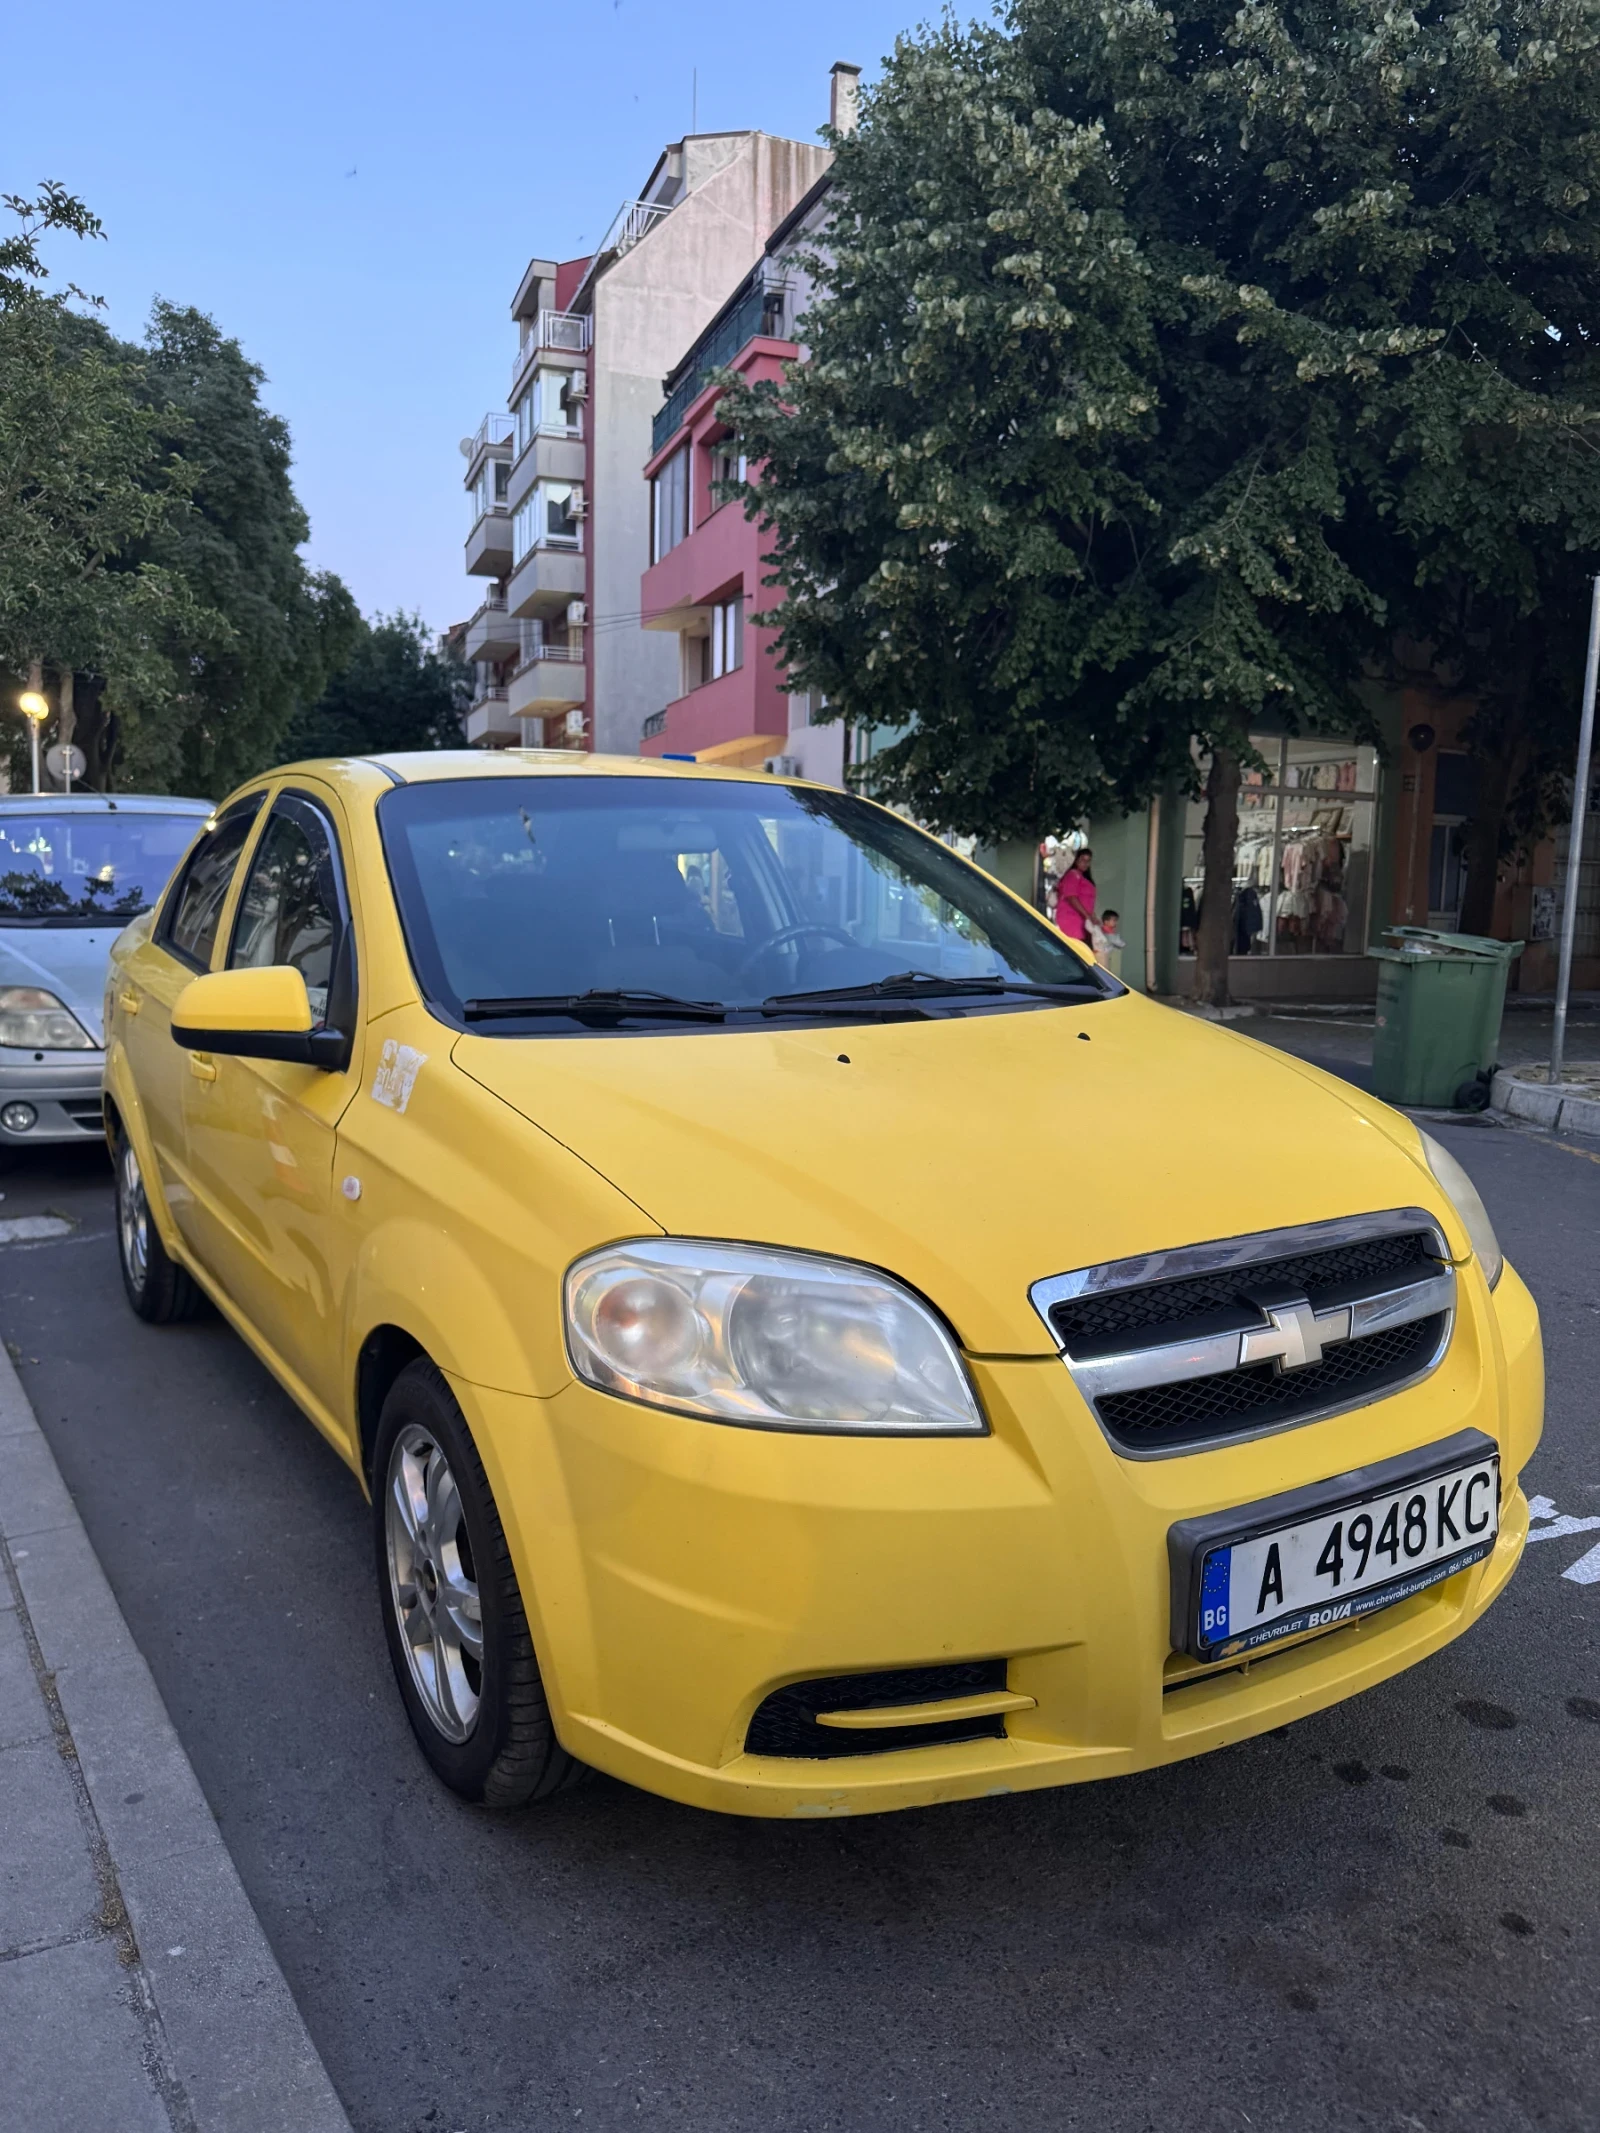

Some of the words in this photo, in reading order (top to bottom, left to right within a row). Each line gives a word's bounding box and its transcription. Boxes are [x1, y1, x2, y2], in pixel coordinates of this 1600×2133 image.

[1249, 1620, 1303, 1645] CHEVROLET
[1307, 1602, 1352, 1628] BOVA
[1355, 1570, 1447, 1612] www.chevrolet-burgas.com
[1256, 1542, 1284, 1615] A
[1204, 1605, 1227, 1631] BG
